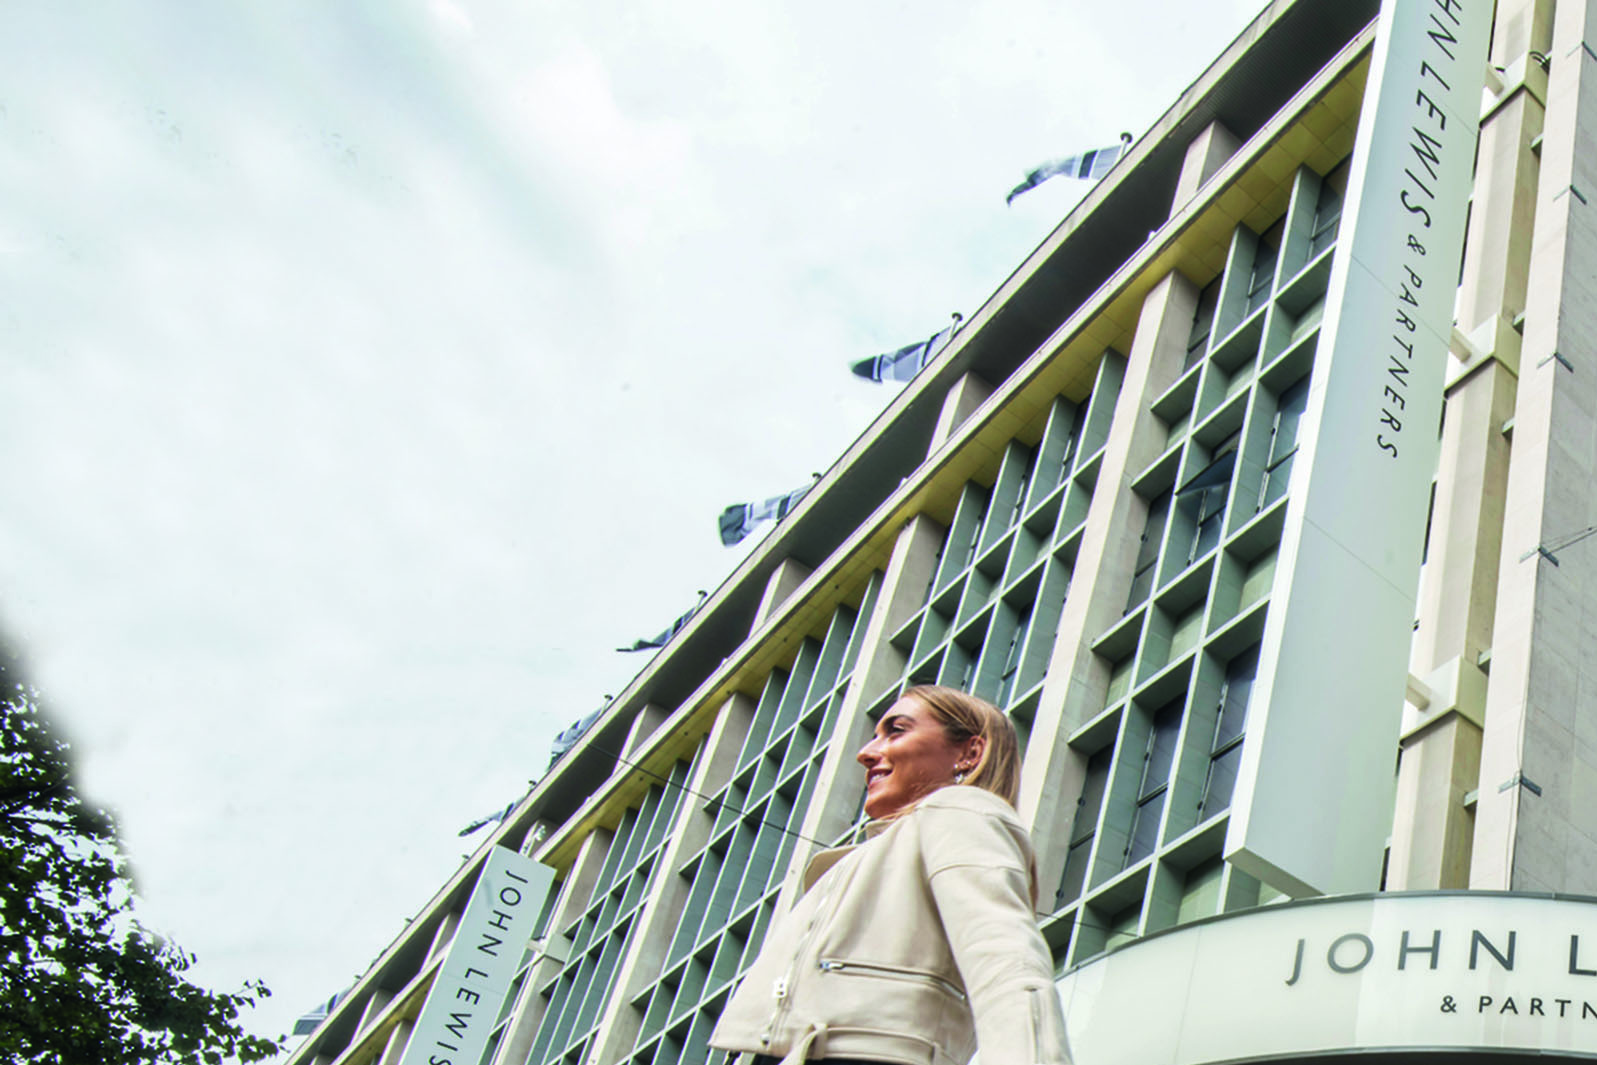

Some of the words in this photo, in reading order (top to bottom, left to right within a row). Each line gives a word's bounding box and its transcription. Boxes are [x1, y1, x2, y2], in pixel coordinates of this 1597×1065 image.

[1427, 0, 1462, 61] HN
[1400, 60, 1452, 228] LEWIS
[1406, 234, 1426, 257] &
[1376, 264, 1424, 459] PARTNERS
[476, 869, 530, 957] JOHN
[1285, 929, 1518, 987] JOHN
[1440, 995, 1457, 1014] &
